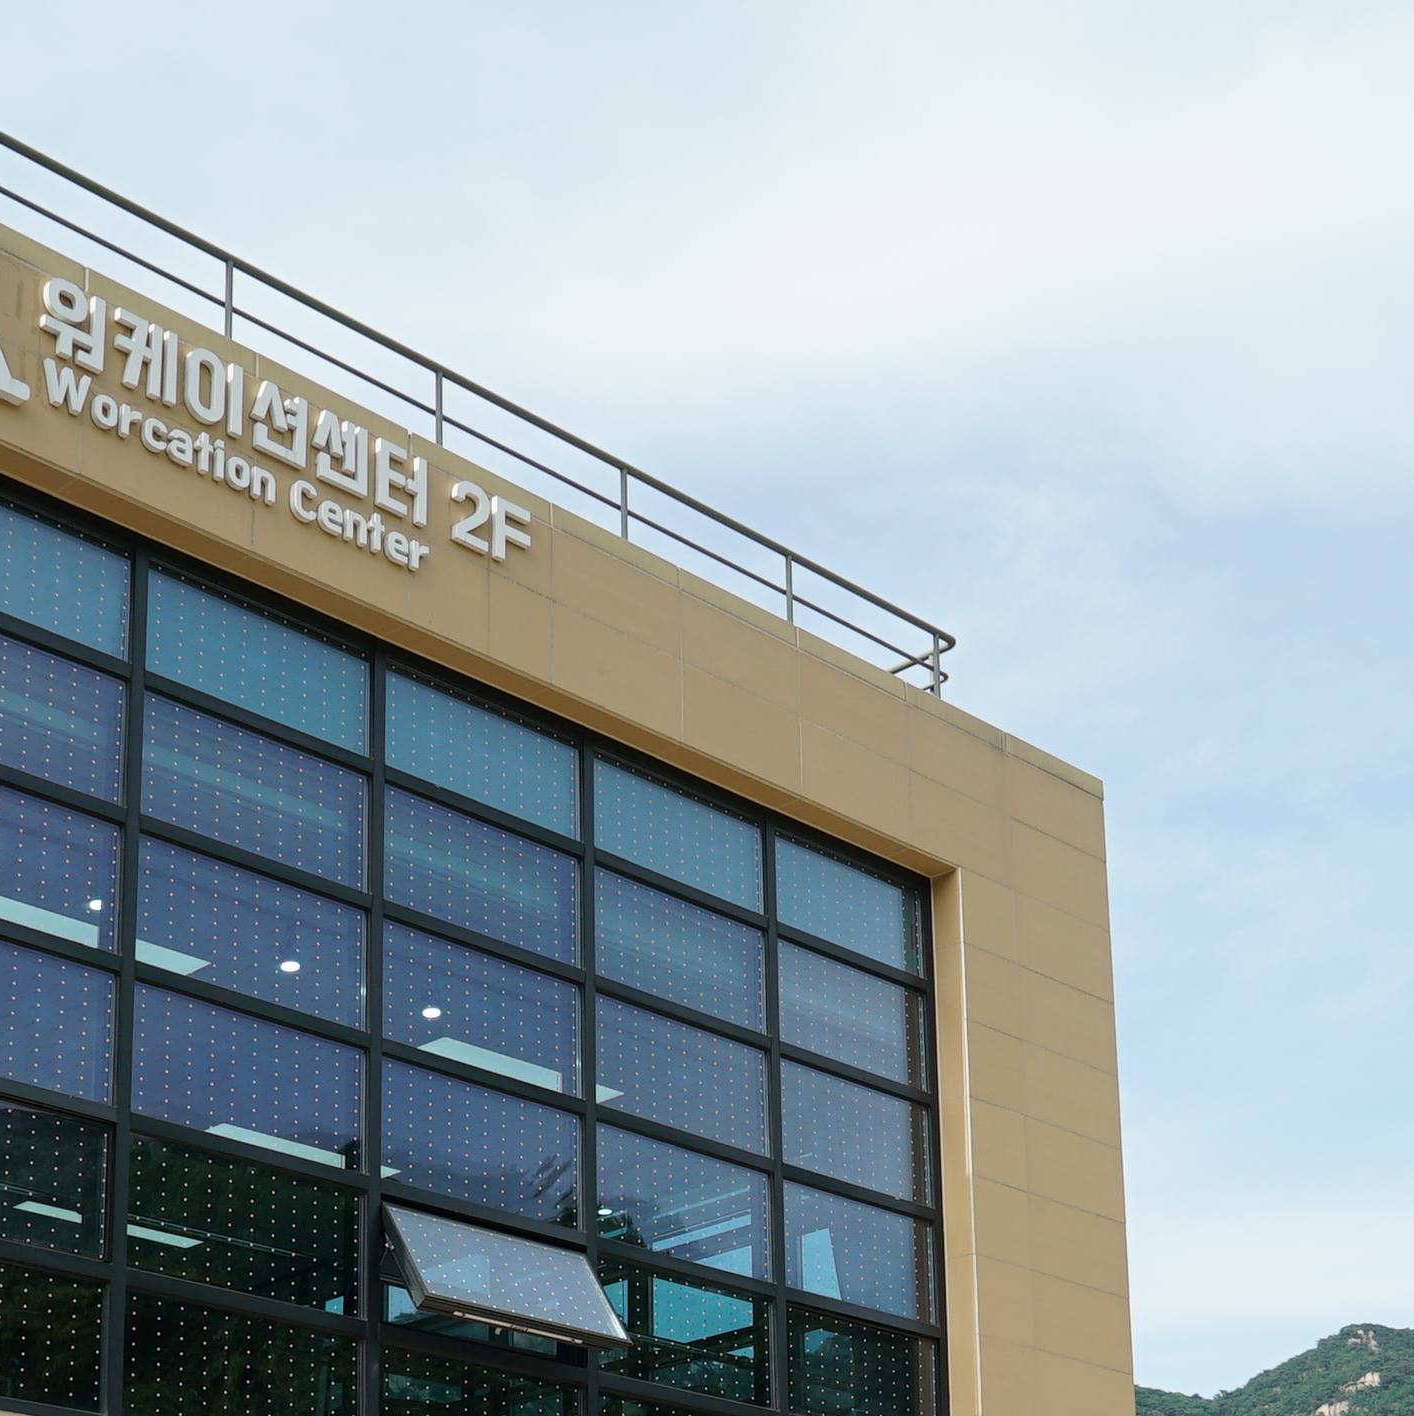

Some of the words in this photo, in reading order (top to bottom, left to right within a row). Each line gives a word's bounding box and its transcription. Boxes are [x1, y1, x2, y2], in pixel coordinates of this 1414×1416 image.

[39, 275, 429, 529] 워케이션센터
[451, 479, 533, 564] 2F
[42, 356, 277, 507] Worcation
[288, 478, 431, 574] Center
